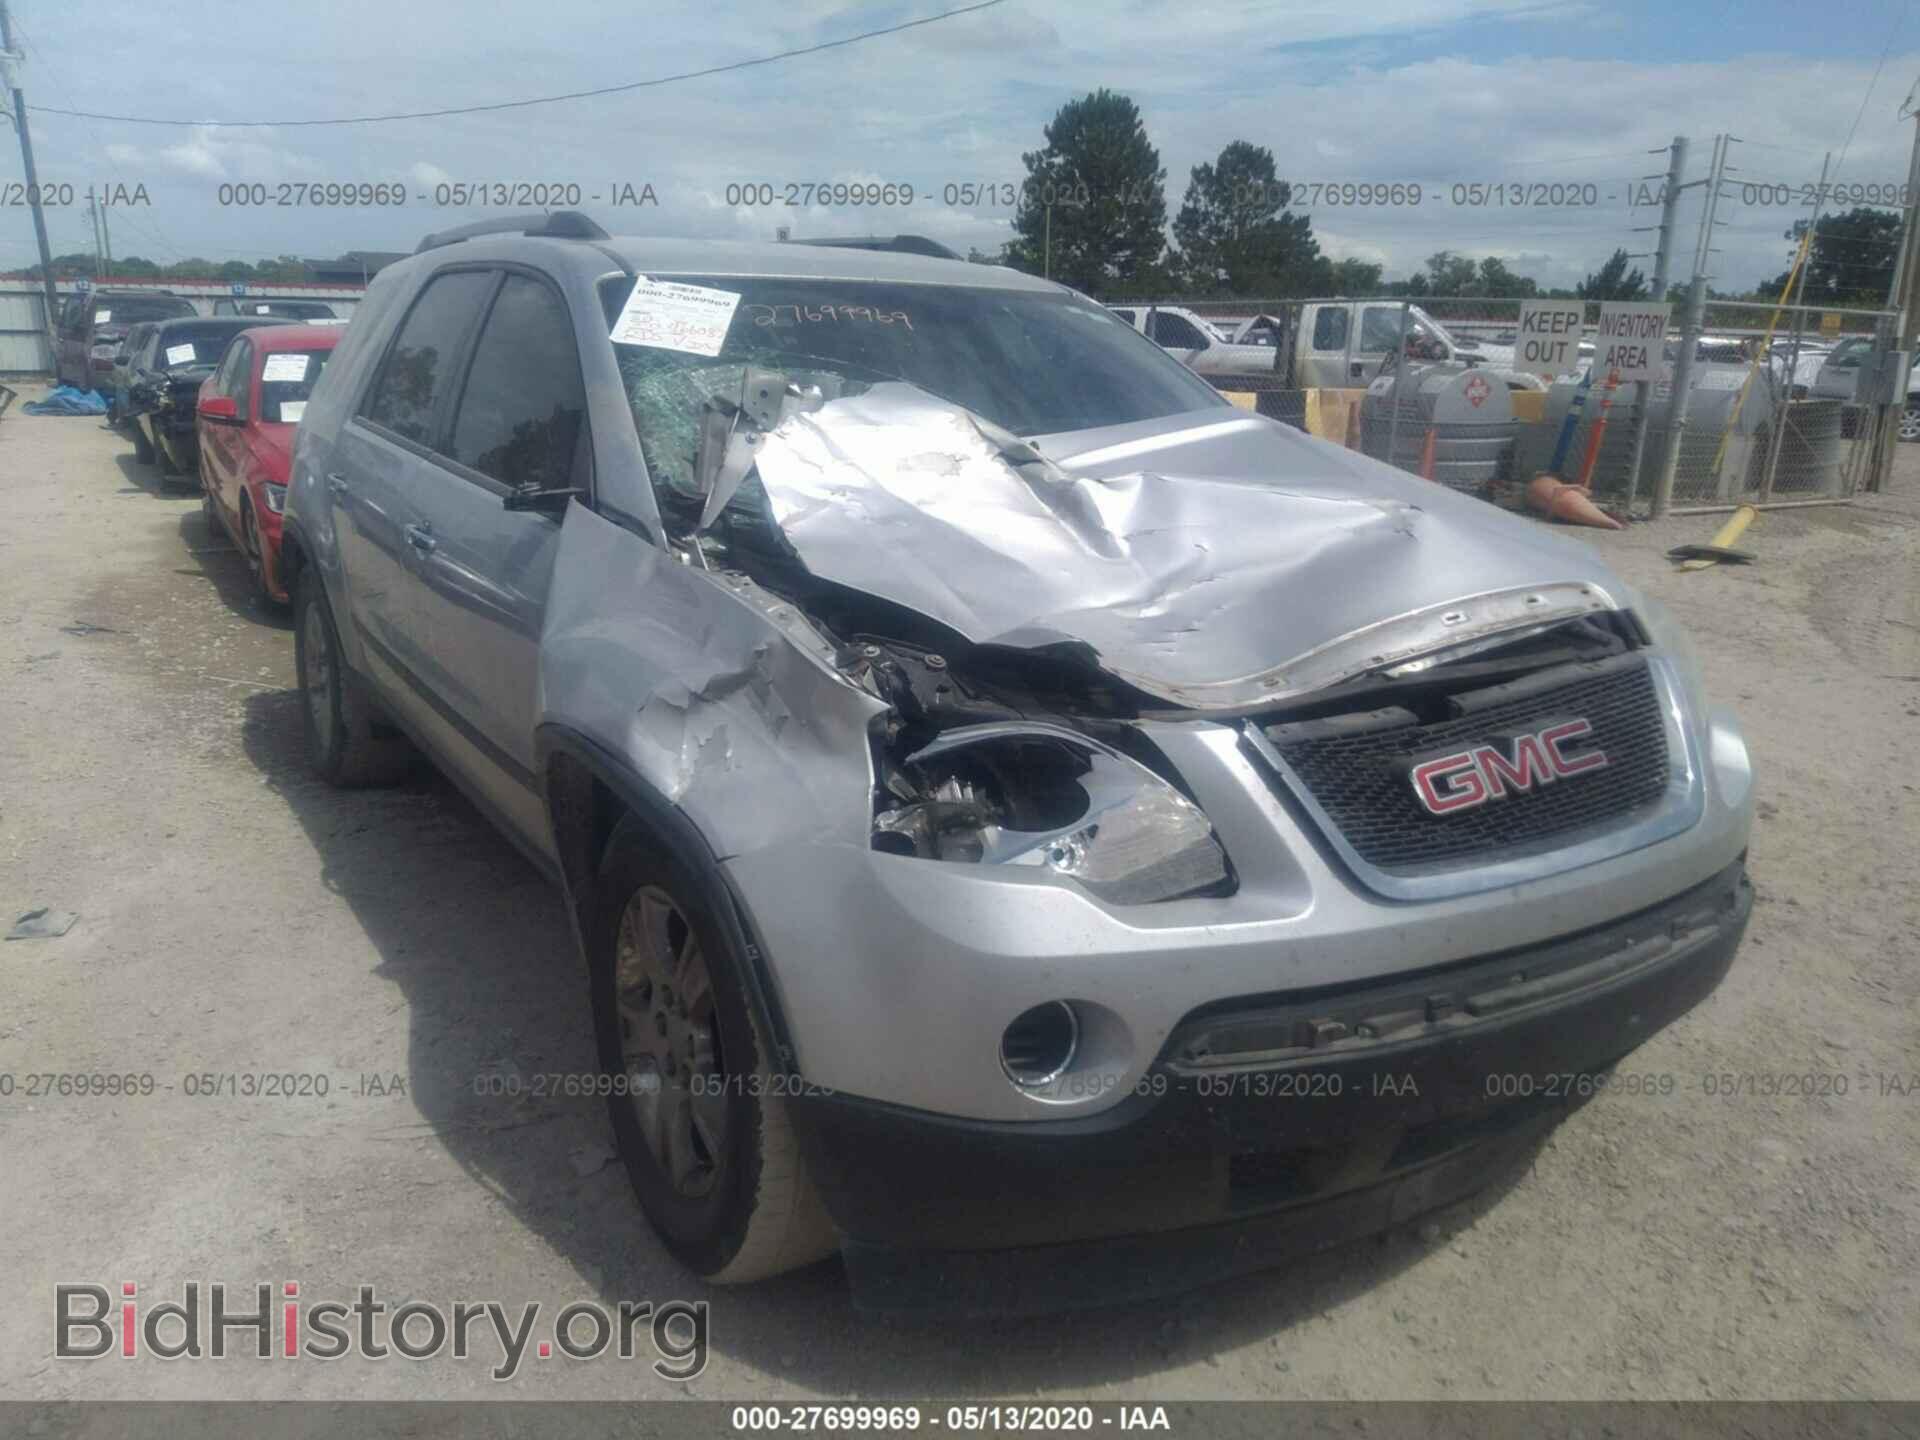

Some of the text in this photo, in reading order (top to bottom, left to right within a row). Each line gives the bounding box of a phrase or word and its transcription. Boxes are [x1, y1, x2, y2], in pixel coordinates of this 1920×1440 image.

[1522, 311, 1579, 333] KEEP
[1599, 312, 1667, 339] INVENTORY
[1524, 340, 1568, 362] OUT
[1604, 345, 1648, 368] AREA
[1412, 717, 1609, 815] GMC
